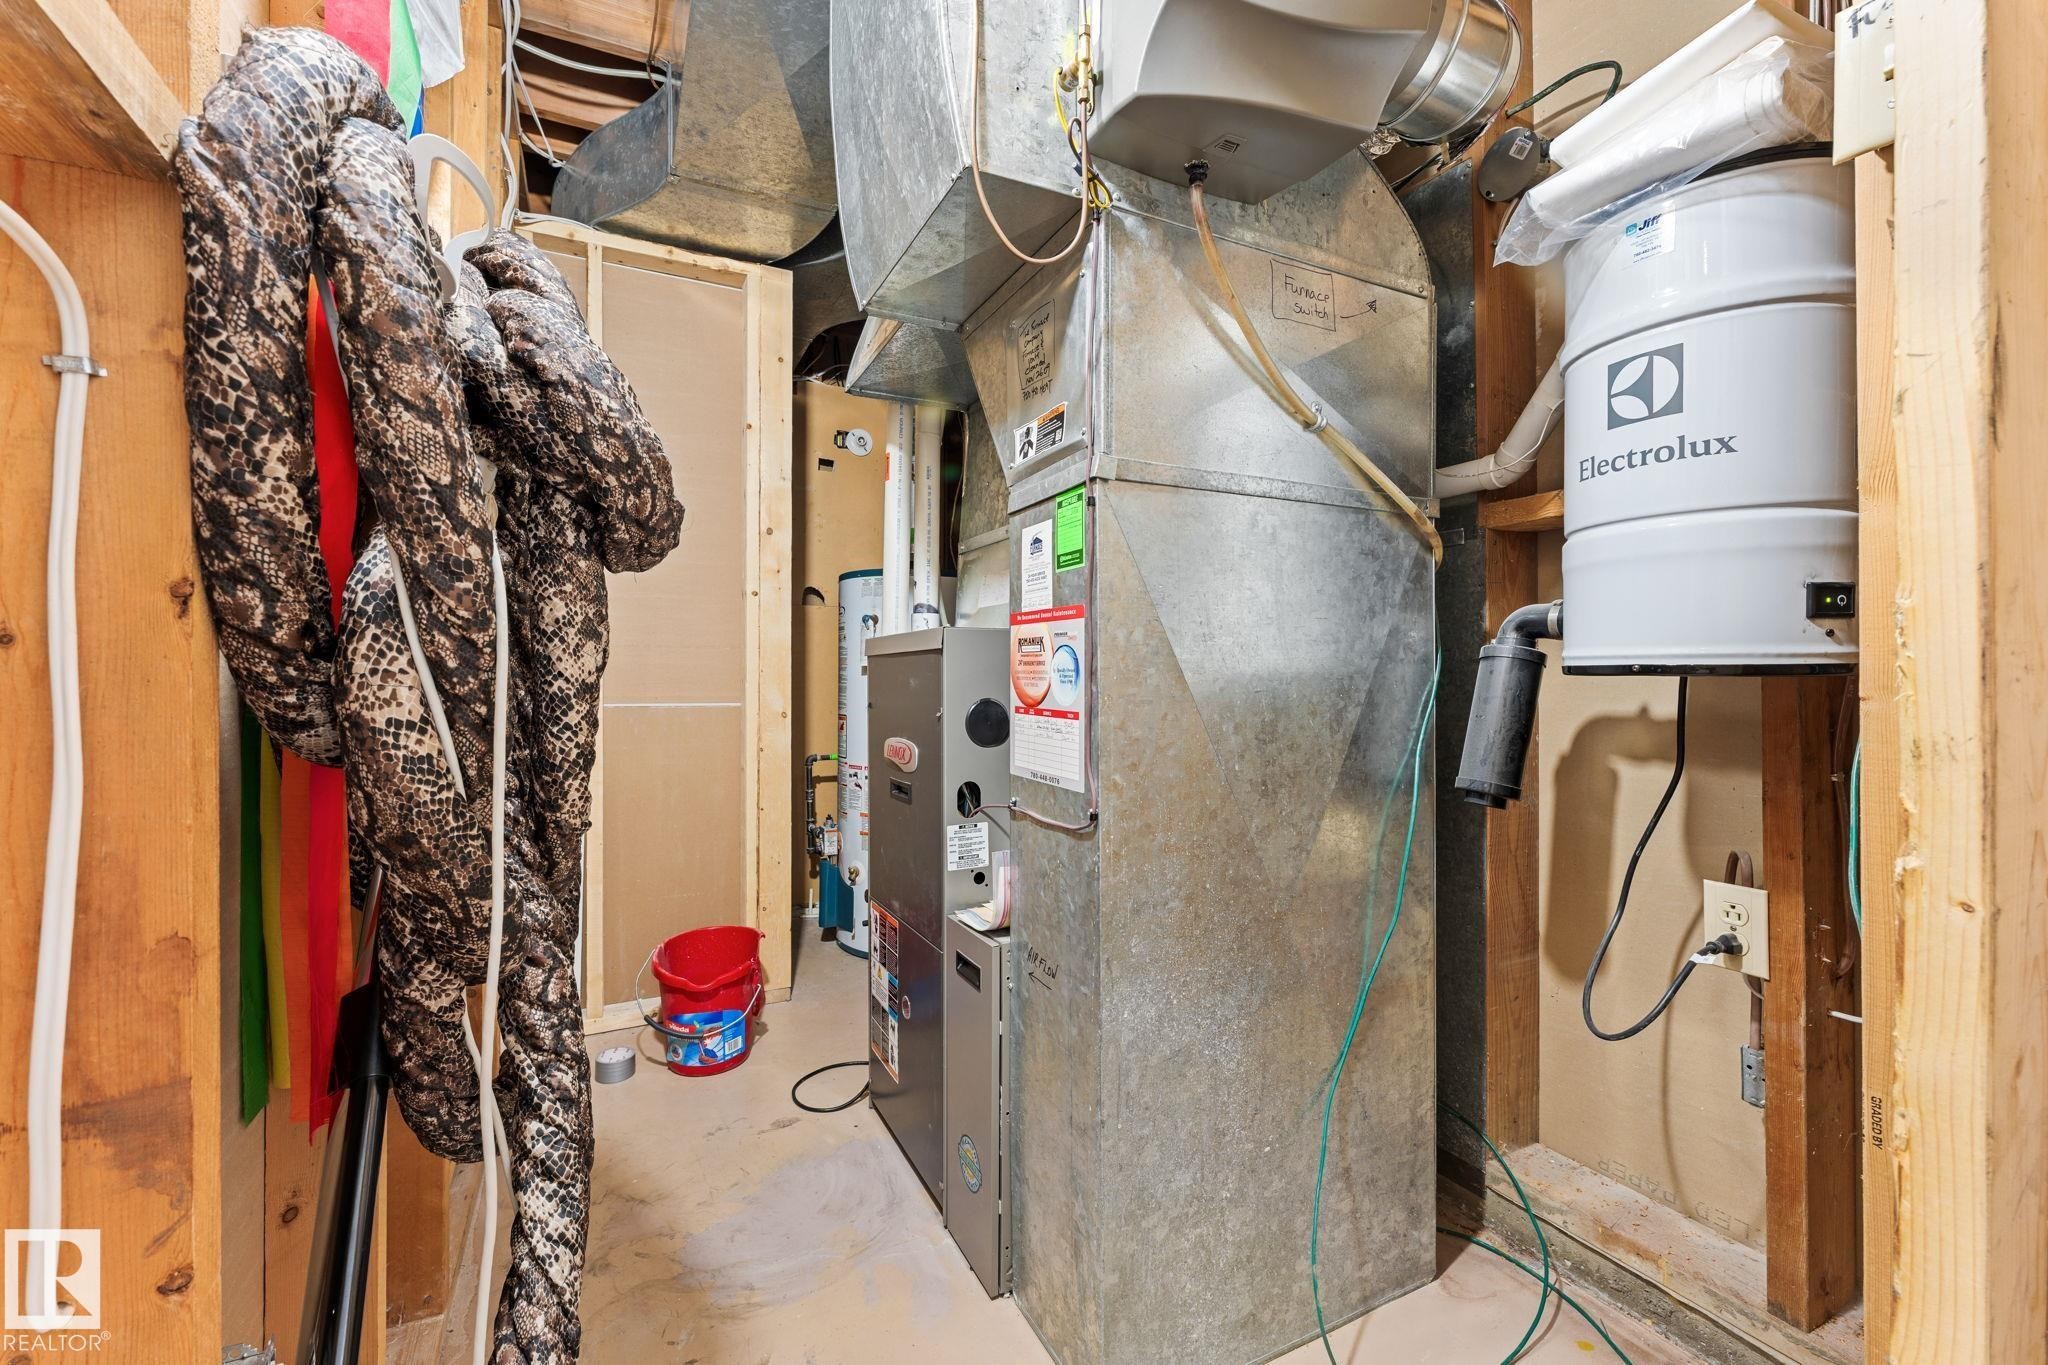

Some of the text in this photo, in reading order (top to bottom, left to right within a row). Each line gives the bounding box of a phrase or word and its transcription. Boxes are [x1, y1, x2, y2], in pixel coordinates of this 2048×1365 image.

[1284, 273, 1330, 303] Furnace
[1578, 434, 1739, 483] Electrolux
[1018, 636, 1046, 653] ROMANIUK
[886, 743, 907, 762] LENNOX
[1870, 1095, 1883, 1151] GRADED BY
